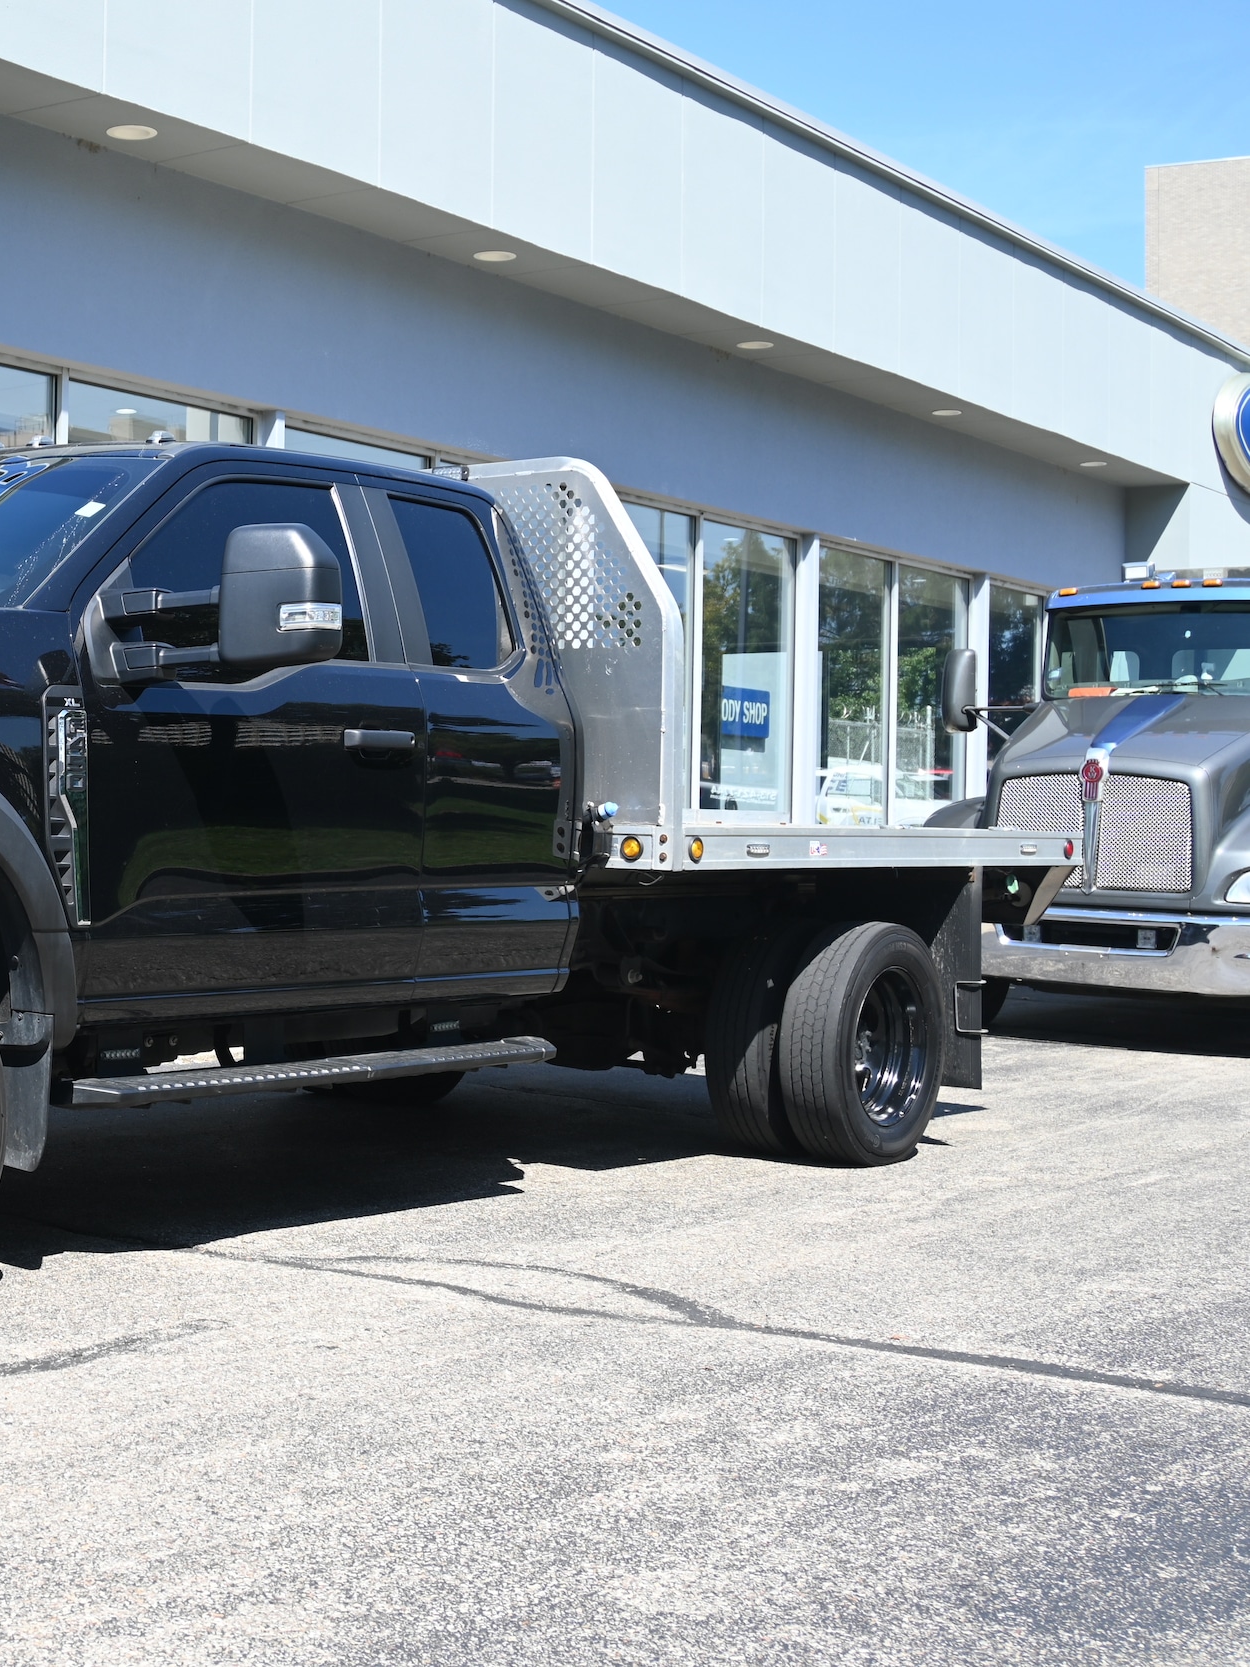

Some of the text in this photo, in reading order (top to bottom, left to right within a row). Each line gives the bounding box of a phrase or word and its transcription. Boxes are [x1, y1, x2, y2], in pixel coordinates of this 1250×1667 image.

[63, 697, 81, 707] XL
[721, 698, 768, 725] ODY SHOP
